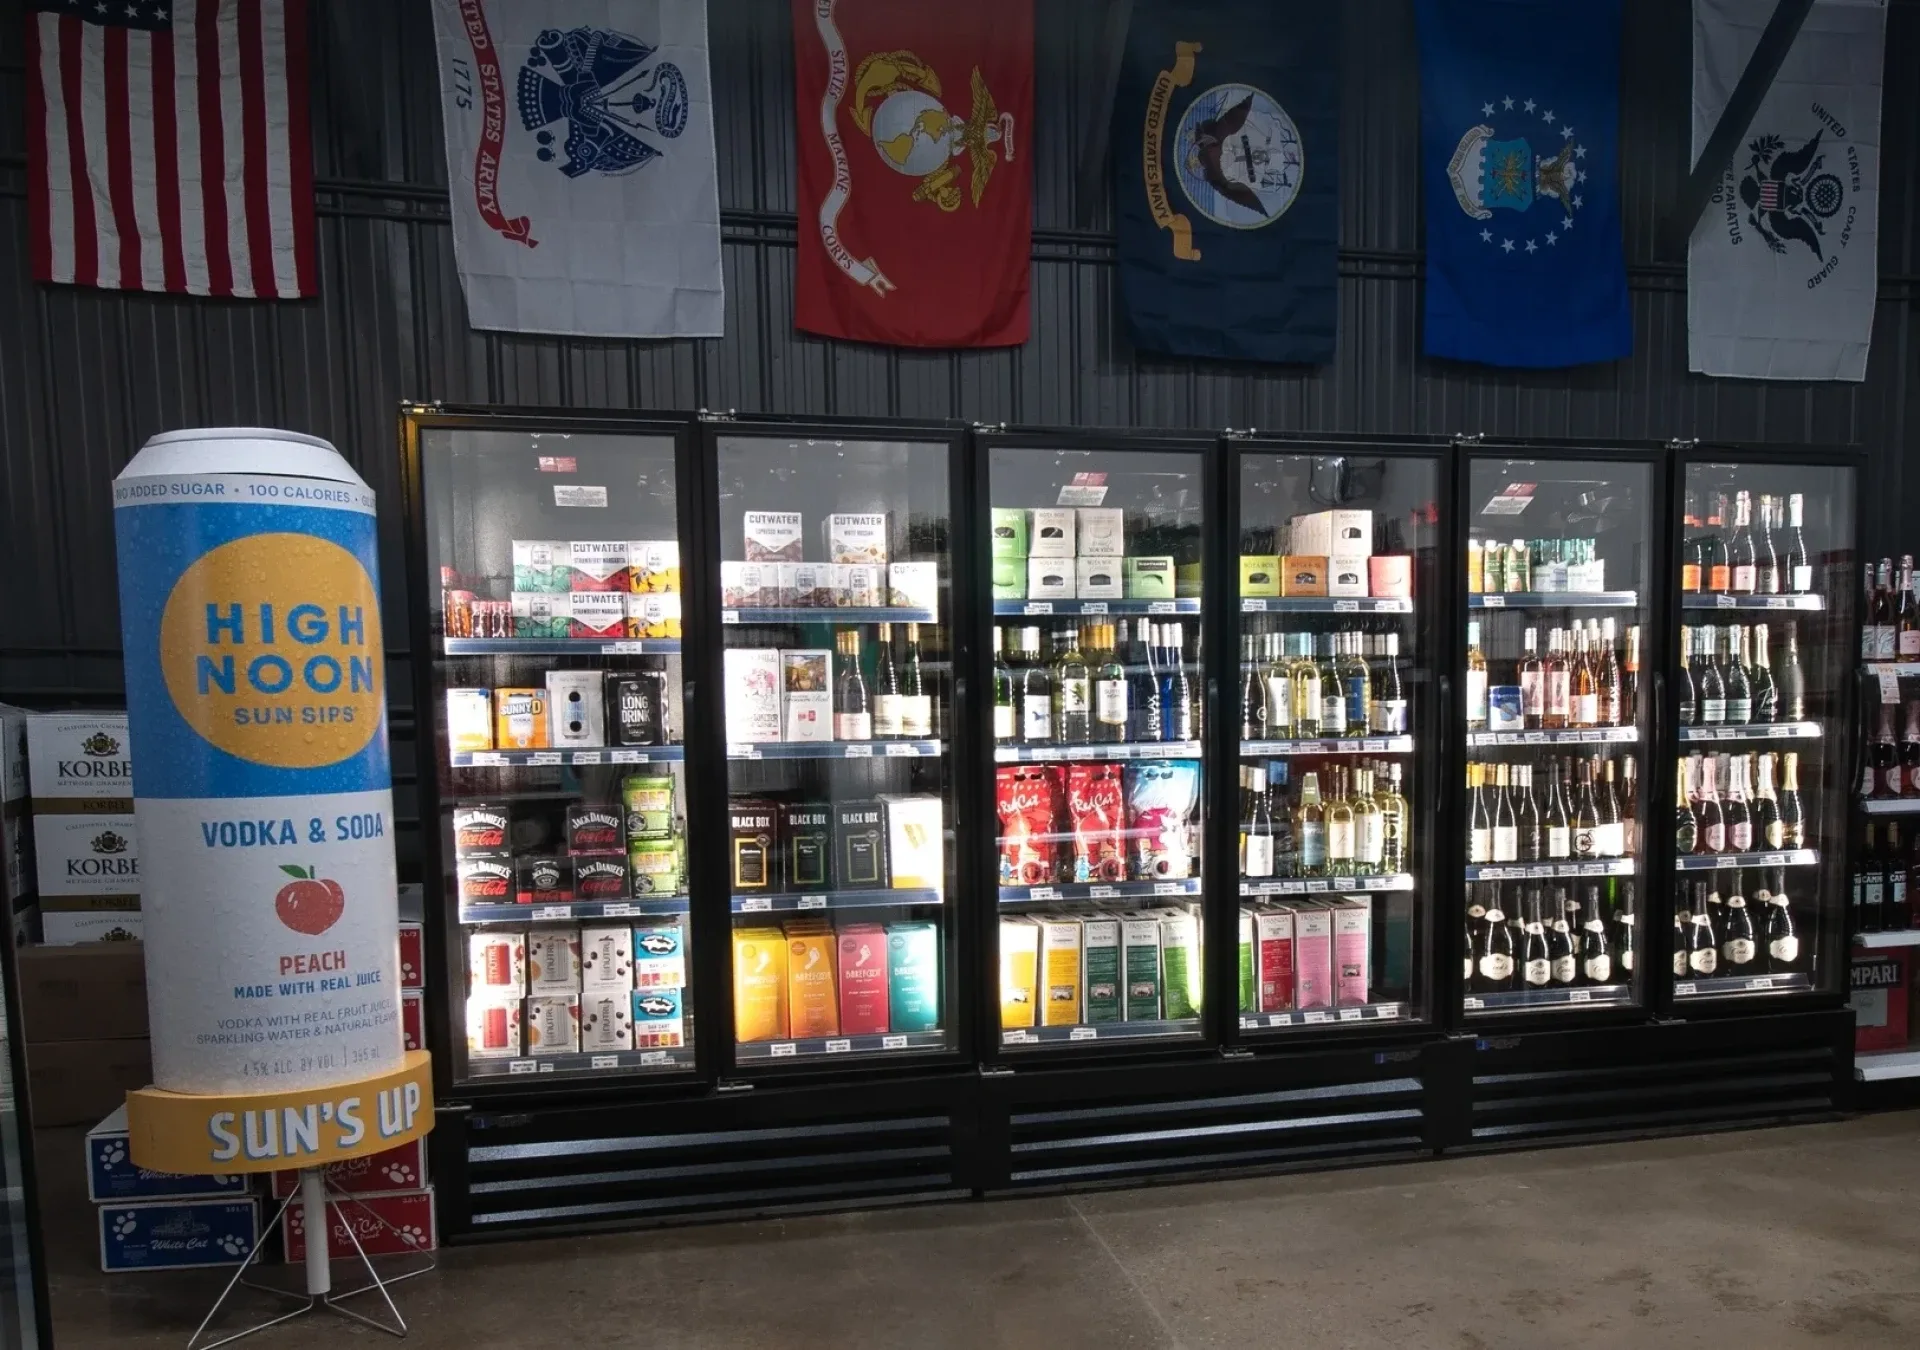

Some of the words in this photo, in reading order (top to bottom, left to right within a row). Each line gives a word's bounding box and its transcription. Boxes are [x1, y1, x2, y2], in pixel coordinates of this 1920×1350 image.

[453, 59, 472, 110] 1775
[831, 50, 847, 99] STATES
[480, 64, 501, 143] STATES
[1147, 77, 1169, 129] UNITED
[1811, 102, 1847, 138] UNITED
[827, 133, 848, 194] MARINE
[1146, 130, 1157, 180] STATES
[1848, 146, 1860, 192] STATES
[479, 151, 498, 214] ARMY
[1149, 182, 1169, 220] NAVY
[1725, 186, 1743, 245] PARATUS
[1840, 206, 1856, 249] COAST
[822, 225, 854, 269] CORPS
[1807, 256, 1839, 290] GUARD
[130, 484, 168, 498] ADDED
[171, 483, 225, 497] SUGAR
[248, 484, 280, 497] 100
[283, 486, 351, 503] CALORIES
[749, 515, 799, 525] CUTWATER
[834, 516, 882, 526] CUTWATER
[573, 543, 625, 552] CUTWATER
[572, 594, 624, 604] CUTWATER
[205, 603, 365, 646] HIGH
[195, 653, 373, 695] NOON
[234, 707, 293, 725] SUN
[301, 706, 356, 724] SIPS
[621, 696, 649, 709] LONG
[1147, 694, 1157, 730] RELAX
[621, 709, 651, 723] DRINK
[57, 761, 132, 778] KORBE
[1000, 799, 1017, 813] Red
[1018, 794, 1039, 810] Cat
[1075, 798, 1095, 813] Red
[1095, 792, 1114, 808] Cat
[201, 818, 298, 848] VODKA
[308, 817, 327, 843] &
[336, 812, 384, 841] SODA
[472, 811, 507, 830] DANIEL'S
[571, 814, 589, 829] JACK
[590, 812, 619, 828] DANIEL'S
[732, 816, 754, 828] BLACK
[756, 816, 770, 827] BOX
[789, 814, 811, 825] BLACK
[812, 813, 826, 825] BOX
[842, 813, 863, 825] BLACK
[864, 812, 878, 823] BOX
[478, 860, 512, 879] DANIEL'S
[578, 865, 596, 878] JACK
[596, 862, 625, 877] DANIEL'S
[279, 950, 346, 976] PEACH
[234, 985, 273, 999] MADE
[278, 978, 315, 995] WITH
[321, 976, 352, 992] REAL
[356, 970, 381, 987] JUICE
[217, 1018, 262, 1030] VODKA
[265, 1014, 300, 1027] WITH
[304, 1010, 335, 1023] REAL
[337, 1005, 367, 1019] FRUIT
[196, 1032, 264, 1045] SPARKLING
[267, 1026, 311, 1042] WATER
[313, 1027, 322, 1037] &
[325, 1019, 372, 1036] NATURAL
[209, 1096, 365, 1162] SUN'S
[377, 1081, 421, 1138] UP
[359, 1219, 385, 1234] Cat
[149, 1239, 185, 1251] White
[186, 1237, 209, 1250] Cat
